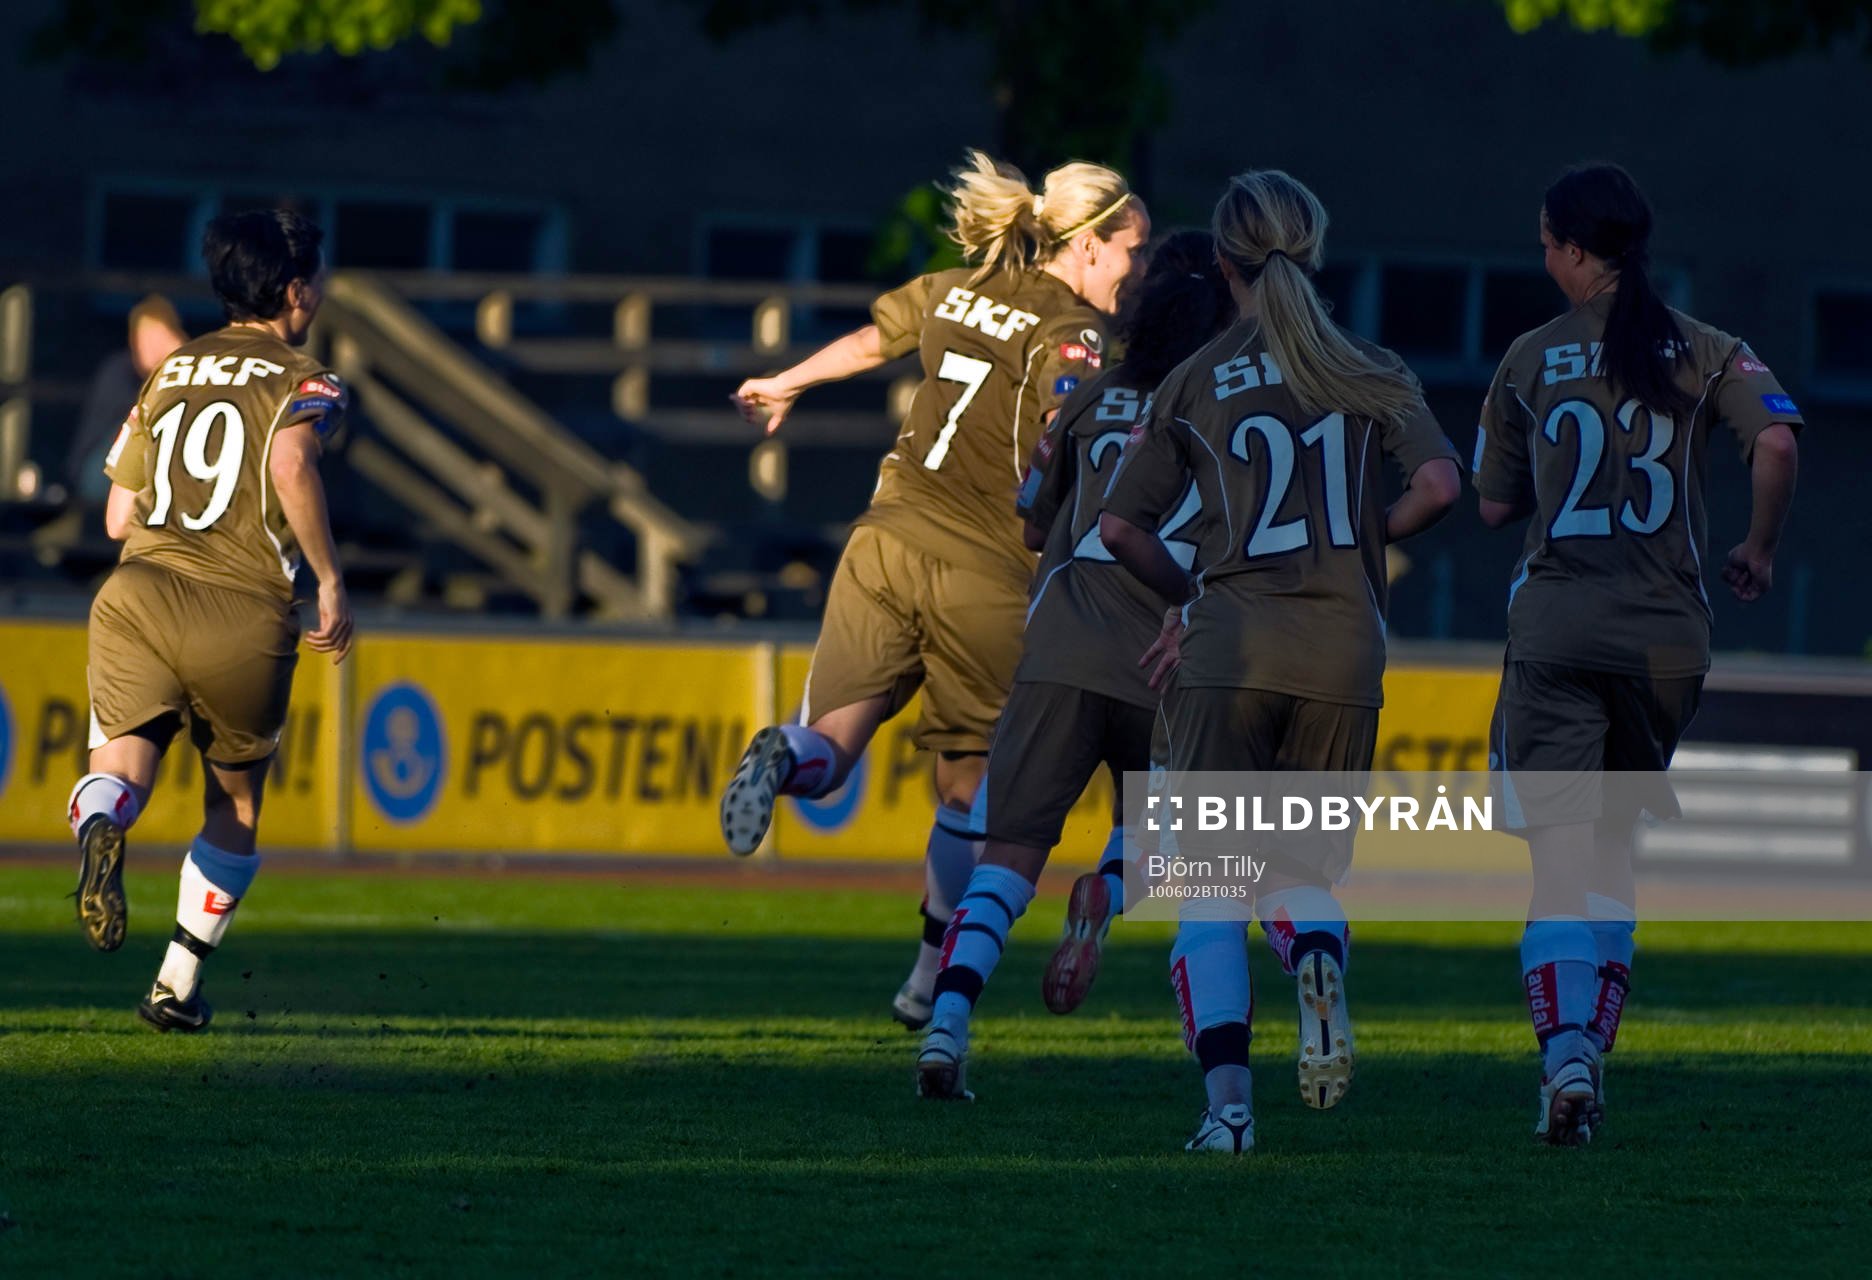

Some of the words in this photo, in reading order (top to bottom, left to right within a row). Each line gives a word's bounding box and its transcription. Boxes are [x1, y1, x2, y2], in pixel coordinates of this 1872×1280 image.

[157, 354, 285, 391] SKF
[933, 286, 1040, 341] SKF
[147, 400, 245, 531] 19
[922, 350, 992, 471] 7
[1542, 397, 1678, 542] 23
[1227, 410, 1358, 562] 21
[1526, 962, 1555, 1035] avdal
